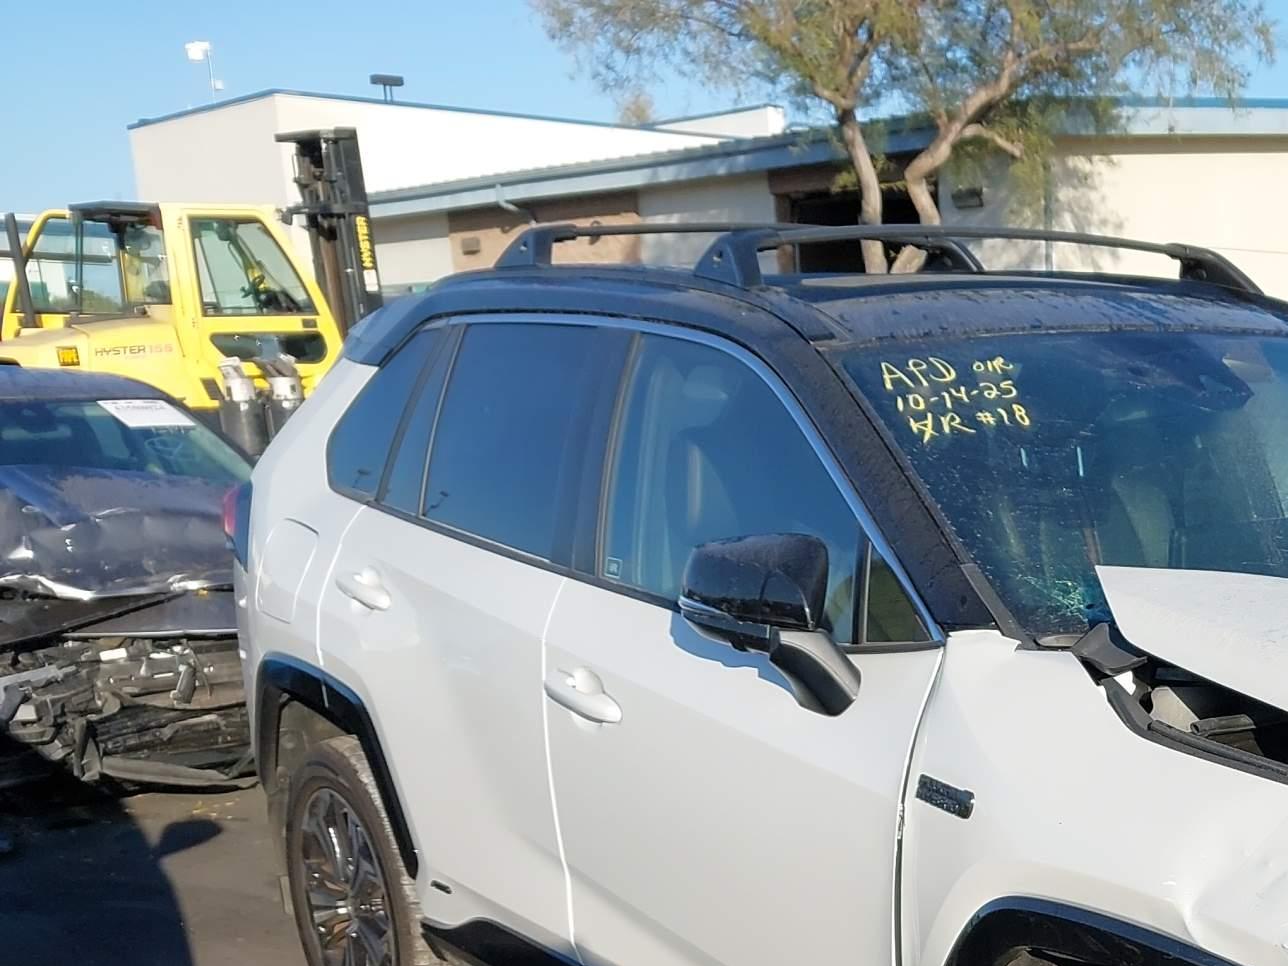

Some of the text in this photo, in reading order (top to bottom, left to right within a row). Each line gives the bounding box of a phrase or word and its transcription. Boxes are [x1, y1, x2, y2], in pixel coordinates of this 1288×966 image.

[95, 345, 146, 357] HYSTER
[880, 356, 957, 390] APD
[896, 380, 1017, 412] 10-14-25
